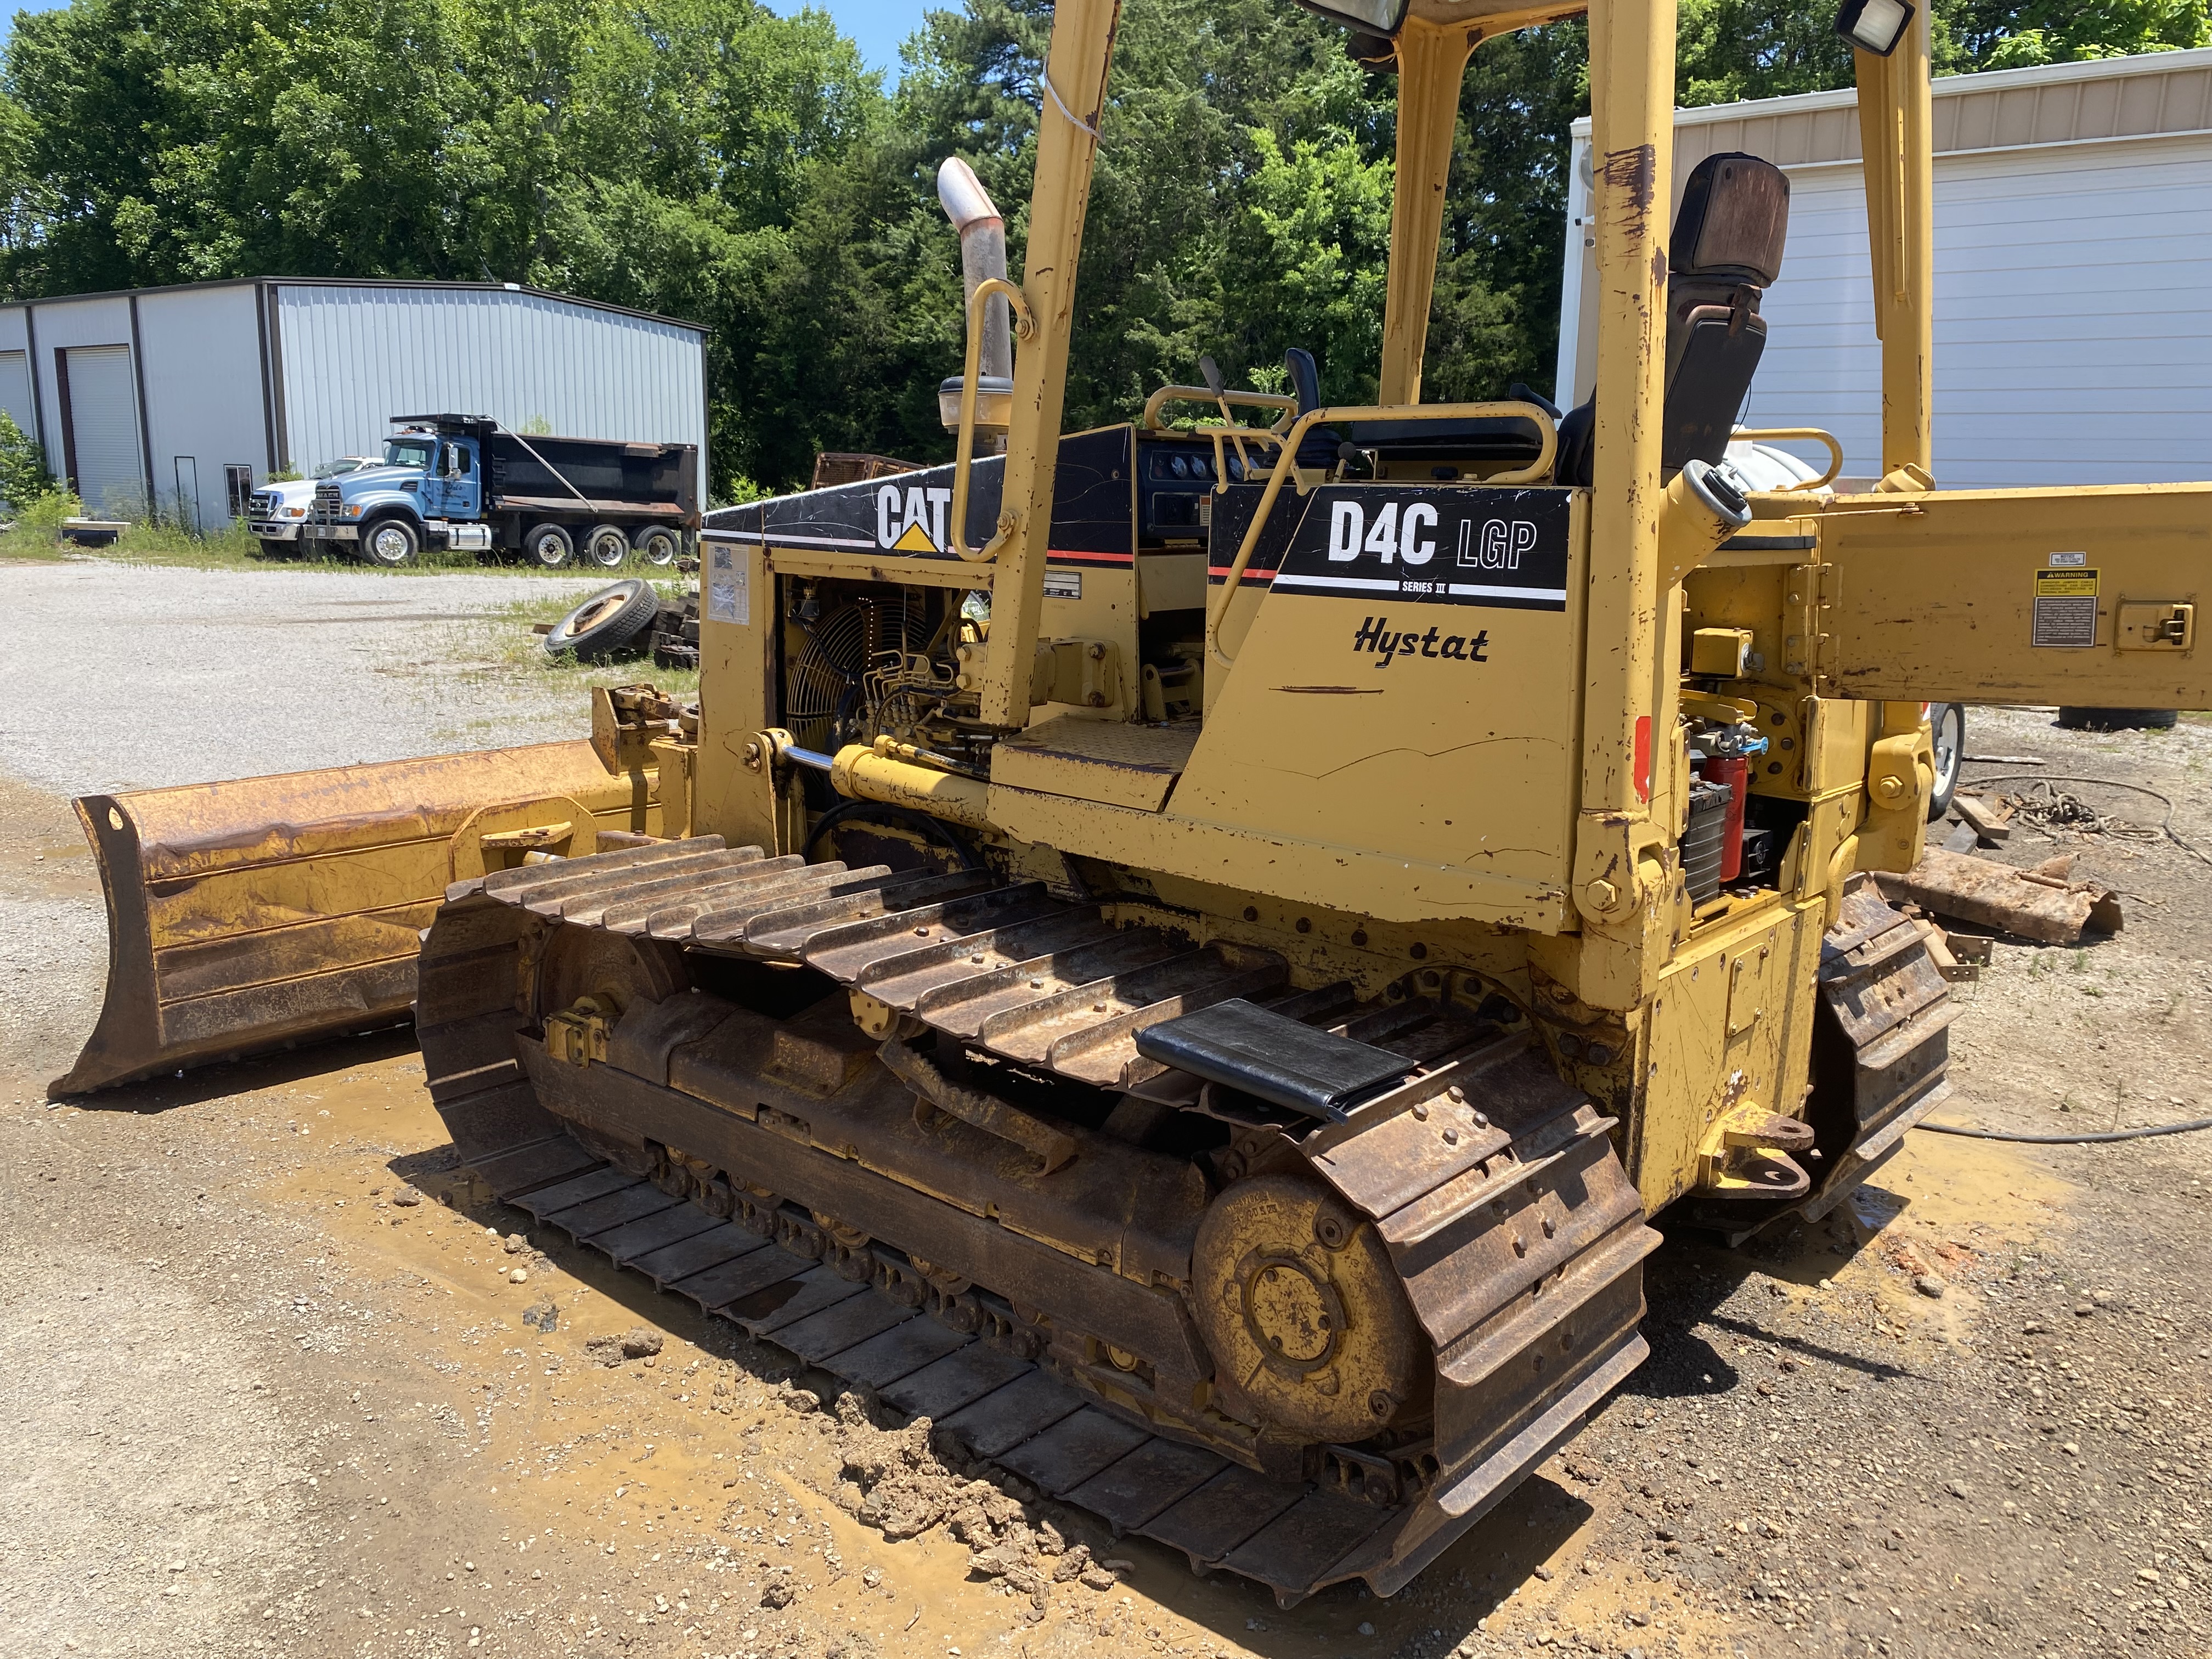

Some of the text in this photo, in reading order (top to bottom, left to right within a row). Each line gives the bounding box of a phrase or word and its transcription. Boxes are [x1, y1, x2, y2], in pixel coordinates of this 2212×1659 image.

[877, 485, 950, 554] CAT
[1328, 500, 1537, 570] D4C LGP
[1402, 580, 1446, 594] SERIES III
[1353, 616, 1490, 669] Hystat
